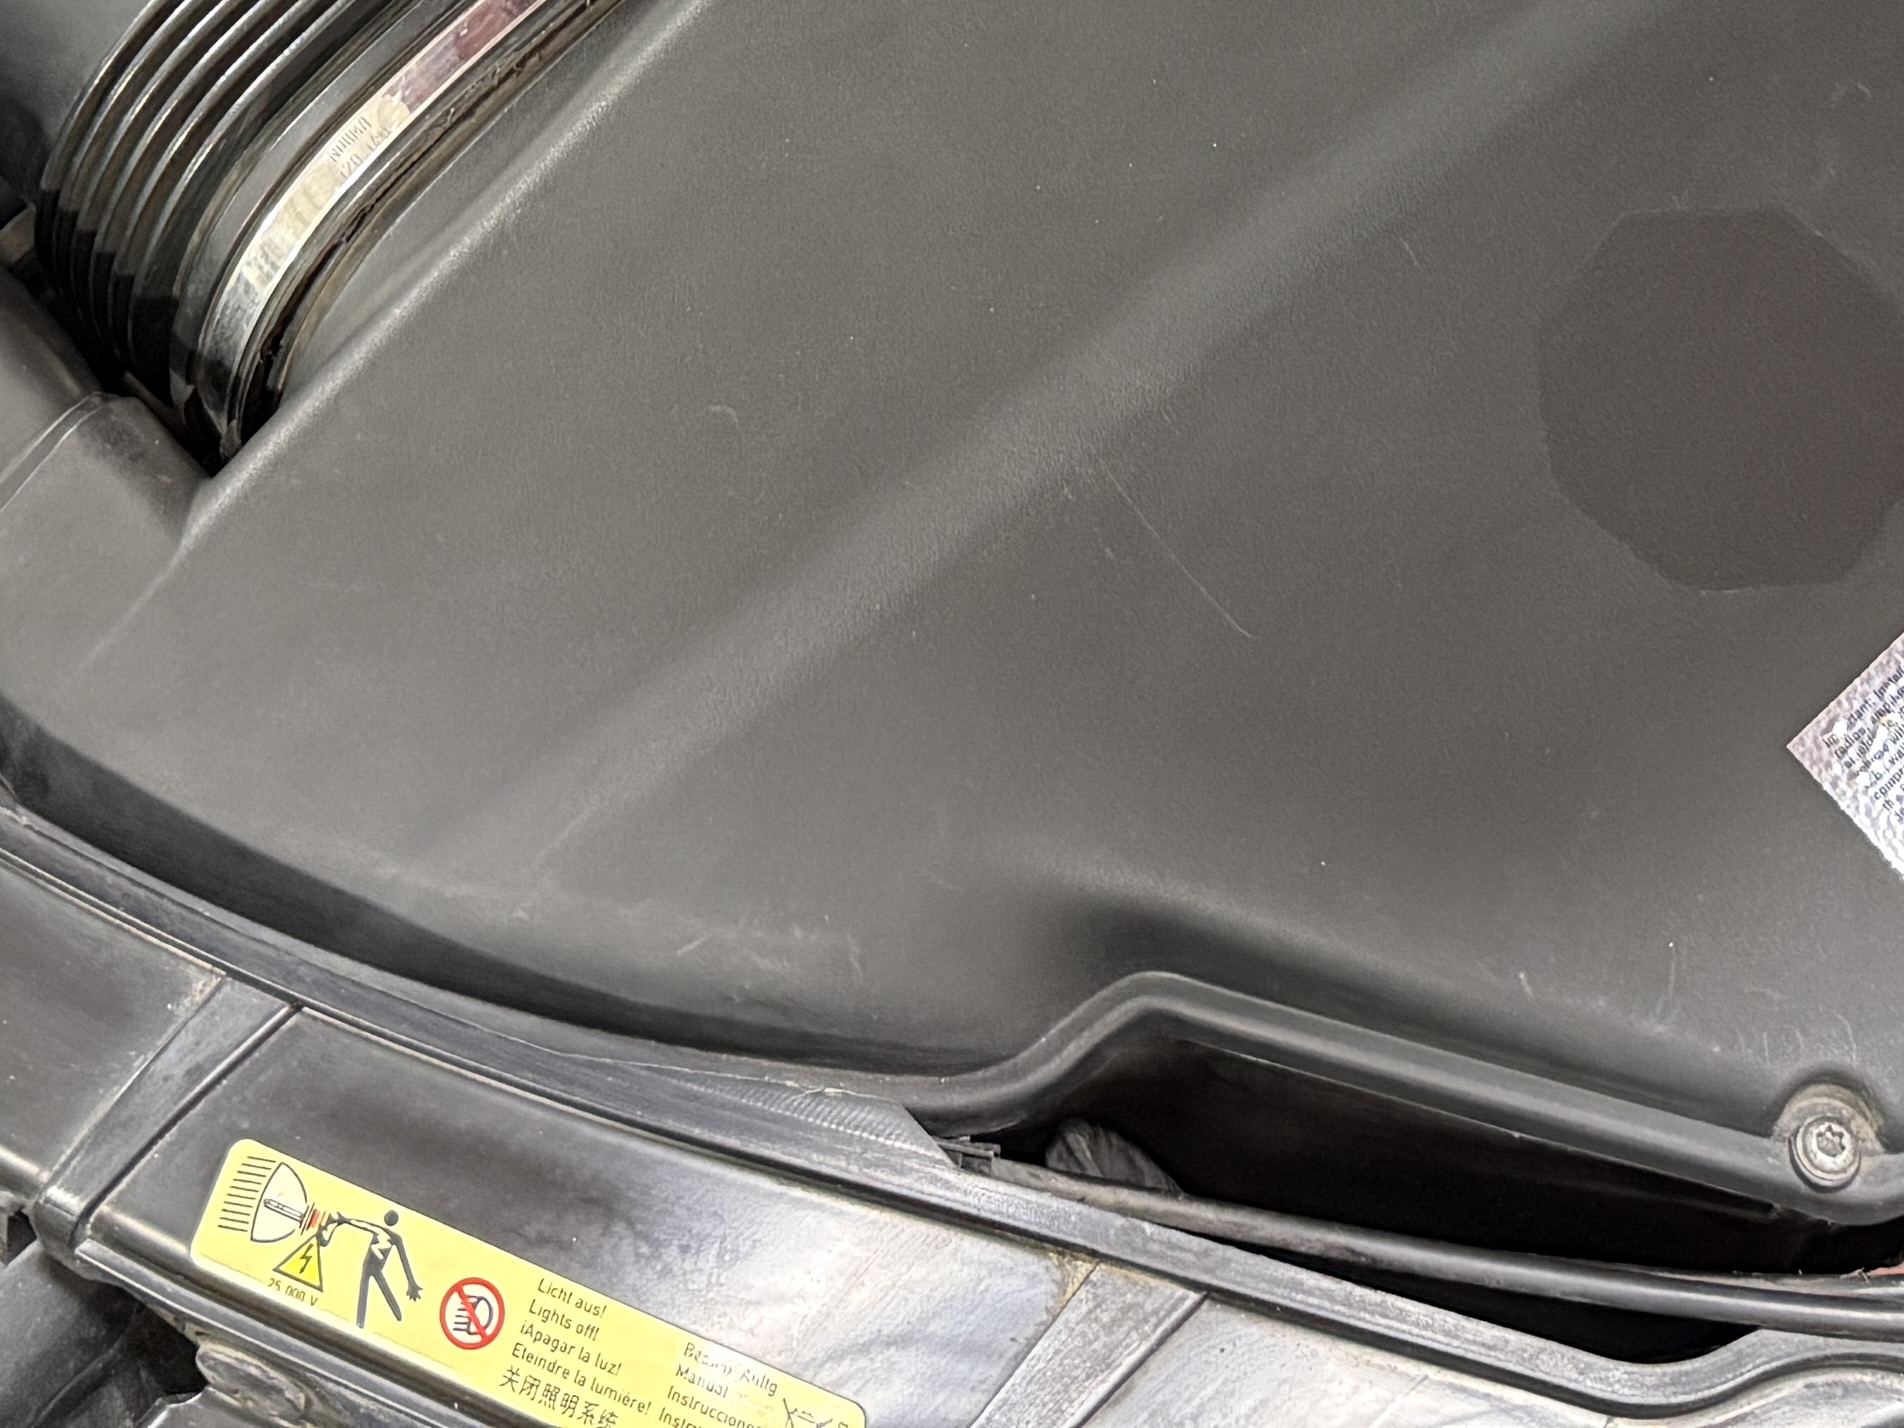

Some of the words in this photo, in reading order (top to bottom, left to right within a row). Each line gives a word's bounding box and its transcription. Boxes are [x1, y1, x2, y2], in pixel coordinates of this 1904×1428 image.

[267, 1277, 283, 1292] 25
[309, 1294, 319, 1306] V
[537, 1277, 573, 1305] Licht
[574, 1296, 608, 1319] aus!
[528, 1298, 573, 1330] Lights
[575, 1322, 600, 1342] off!
[578, 1345, 592, 1363] la
[594, 1352, 622, 1376] luz!
[573, 1369, 587, 1387] la
